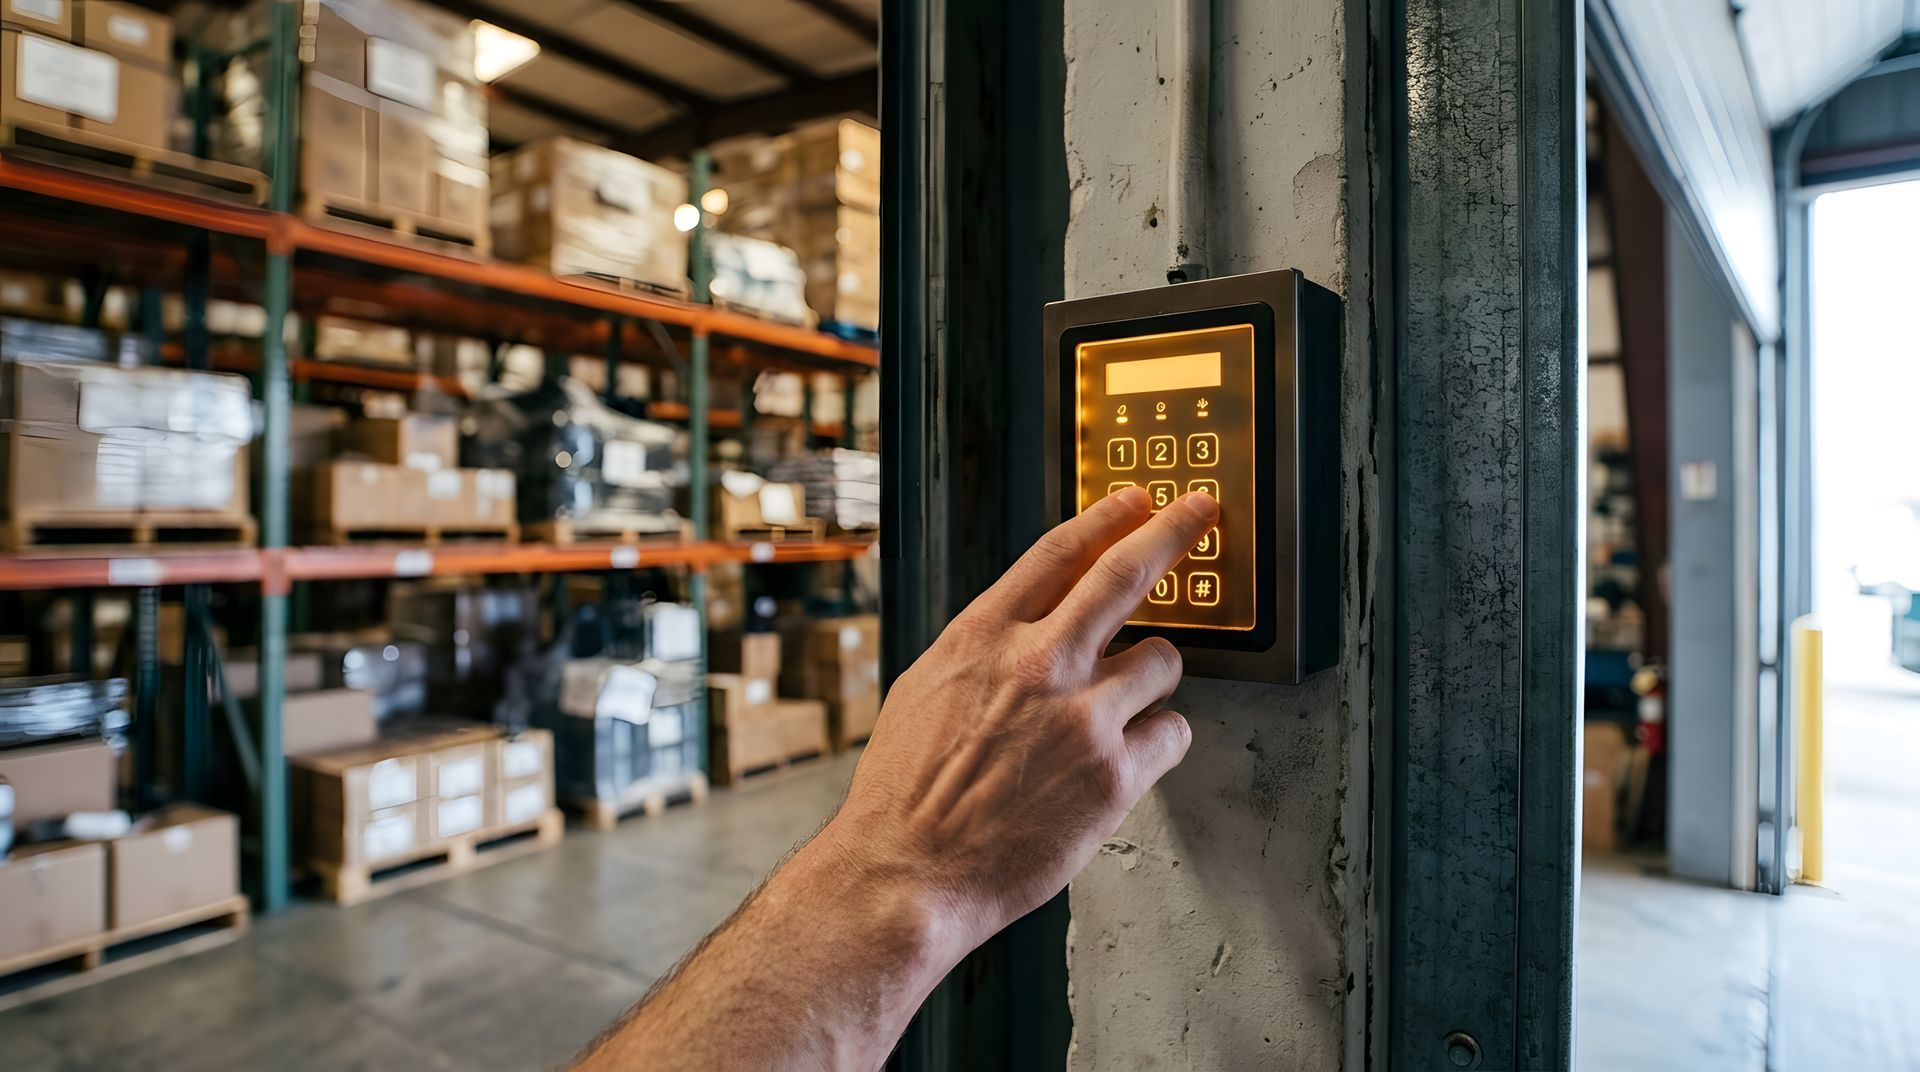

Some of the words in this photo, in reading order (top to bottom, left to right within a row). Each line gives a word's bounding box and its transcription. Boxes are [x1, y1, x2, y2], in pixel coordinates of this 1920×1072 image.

[1117, 444, 1124, 463] 1
[1155, 442, 1167, 461] 2
[1196, 440, 1209, 460] 3
[1155, 487, 1167, 506] 5
[1155, 578, 1168, 597] 0
[1194, 579, 1212, 597] #
